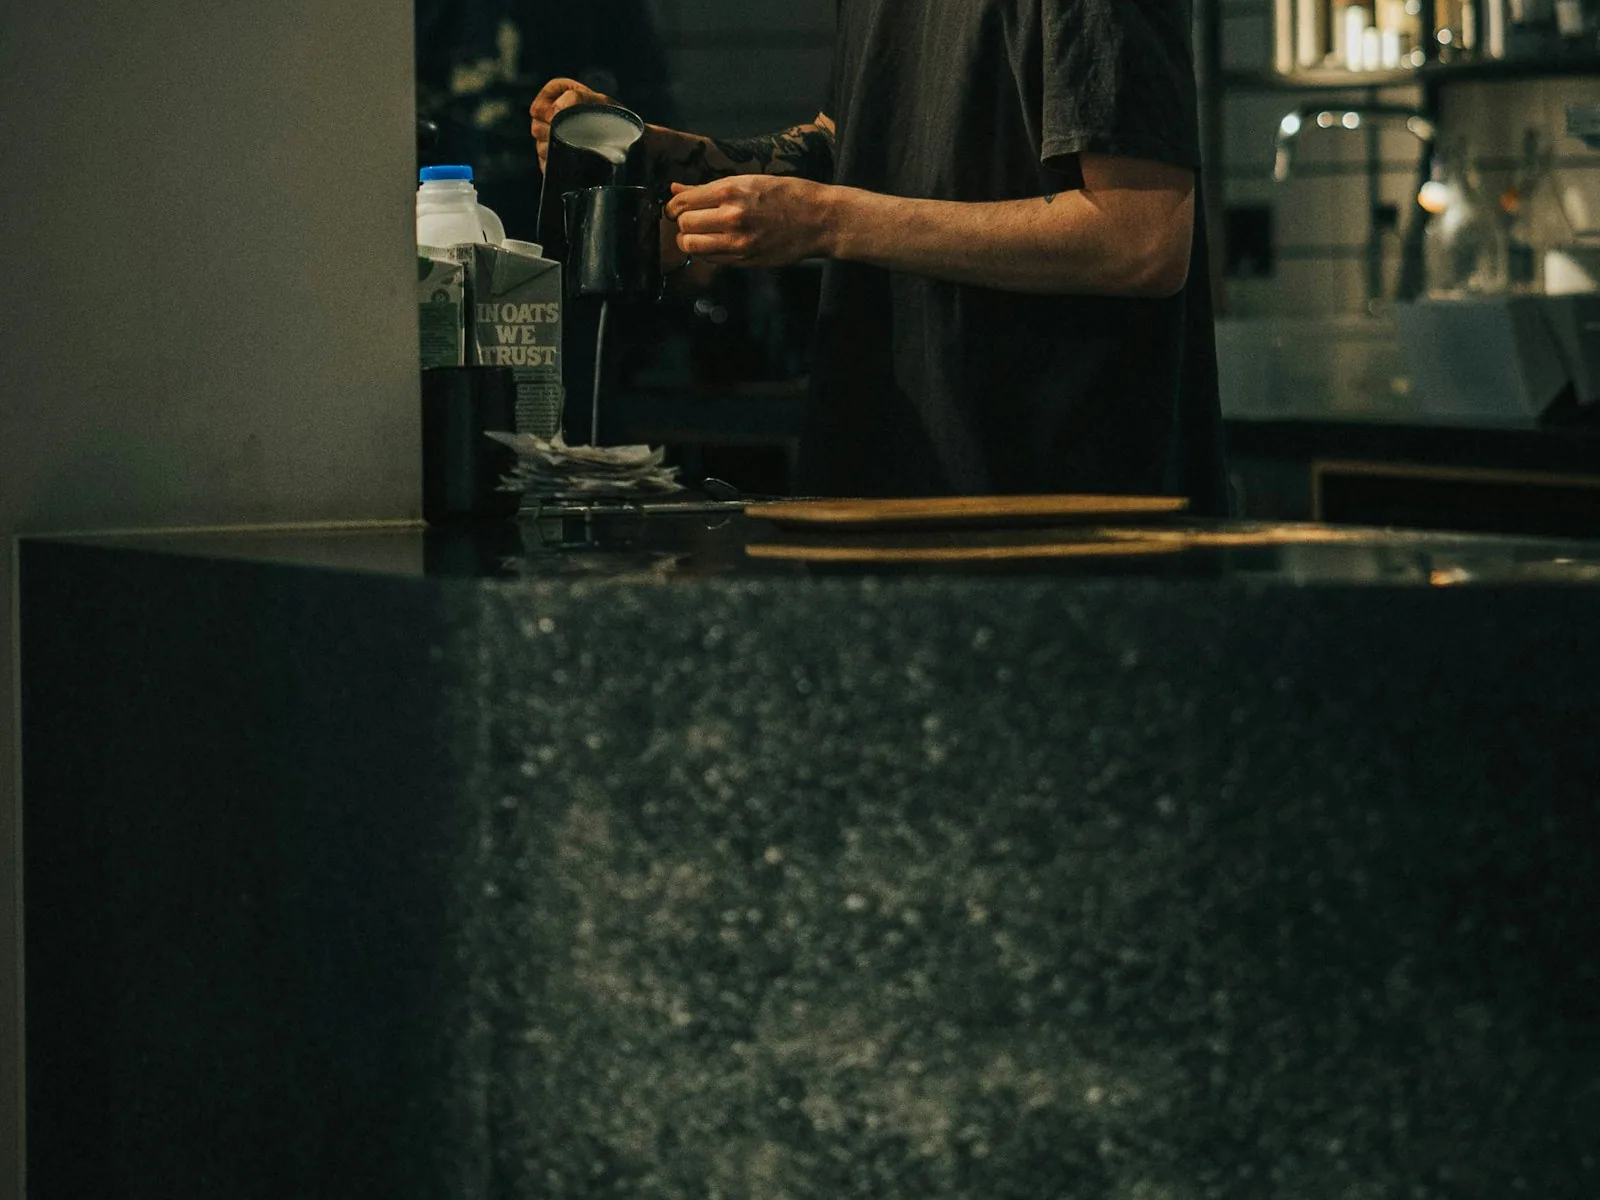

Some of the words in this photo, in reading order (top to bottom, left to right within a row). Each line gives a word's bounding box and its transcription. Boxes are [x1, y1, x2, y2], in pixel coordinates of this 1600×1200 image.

[476, 303, 500, 323] IN
[501, 302, 560, 324] OATS
[495, 324, 536, 345] WE
[481, 345, 557, 366] TRUST
